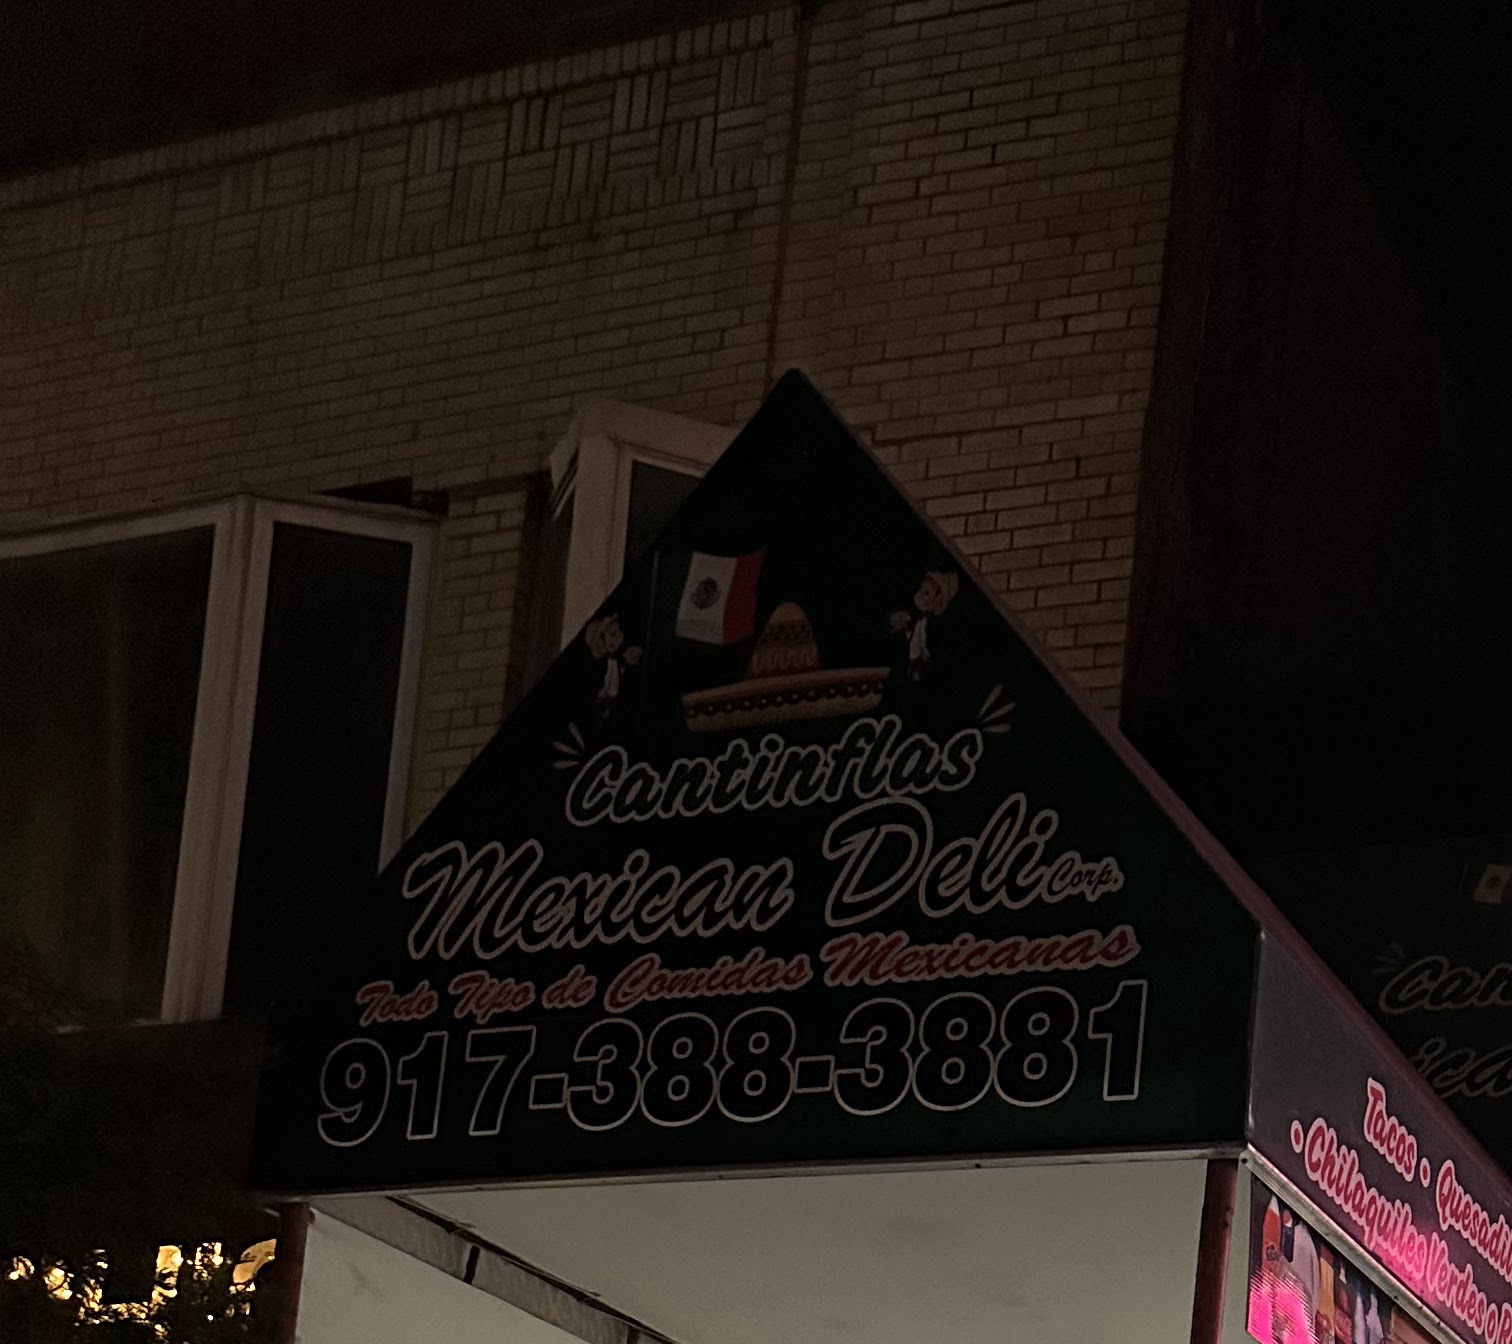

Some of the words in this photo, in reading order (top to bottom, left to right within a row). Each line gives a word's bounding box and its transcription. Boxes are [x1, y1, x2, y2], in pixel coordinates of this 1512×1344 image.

[566, 715, 983, 827] Cantinflas
[403, 838, 795, 961] Mexican
[822, 792, 1056, 927] Deli
[1042, 851, 1124, 901] Corp.
[355, 981, 438, 1026] Todo
[448, 970, 535, 1025] Tipo
[541, 965, 598, 1009] de
[603, 946, 814, 1014] Comidas
[820, 924, 1141, 987] Mexicanas
[317, 980, 1150, 1150] 917-388-3881
[1363, 1077, 1418, 1183] Tacos
[1305, 1117, 1427, 1281] Chilaquiles
[1427, 1232, 1487, 1335] Verdes
